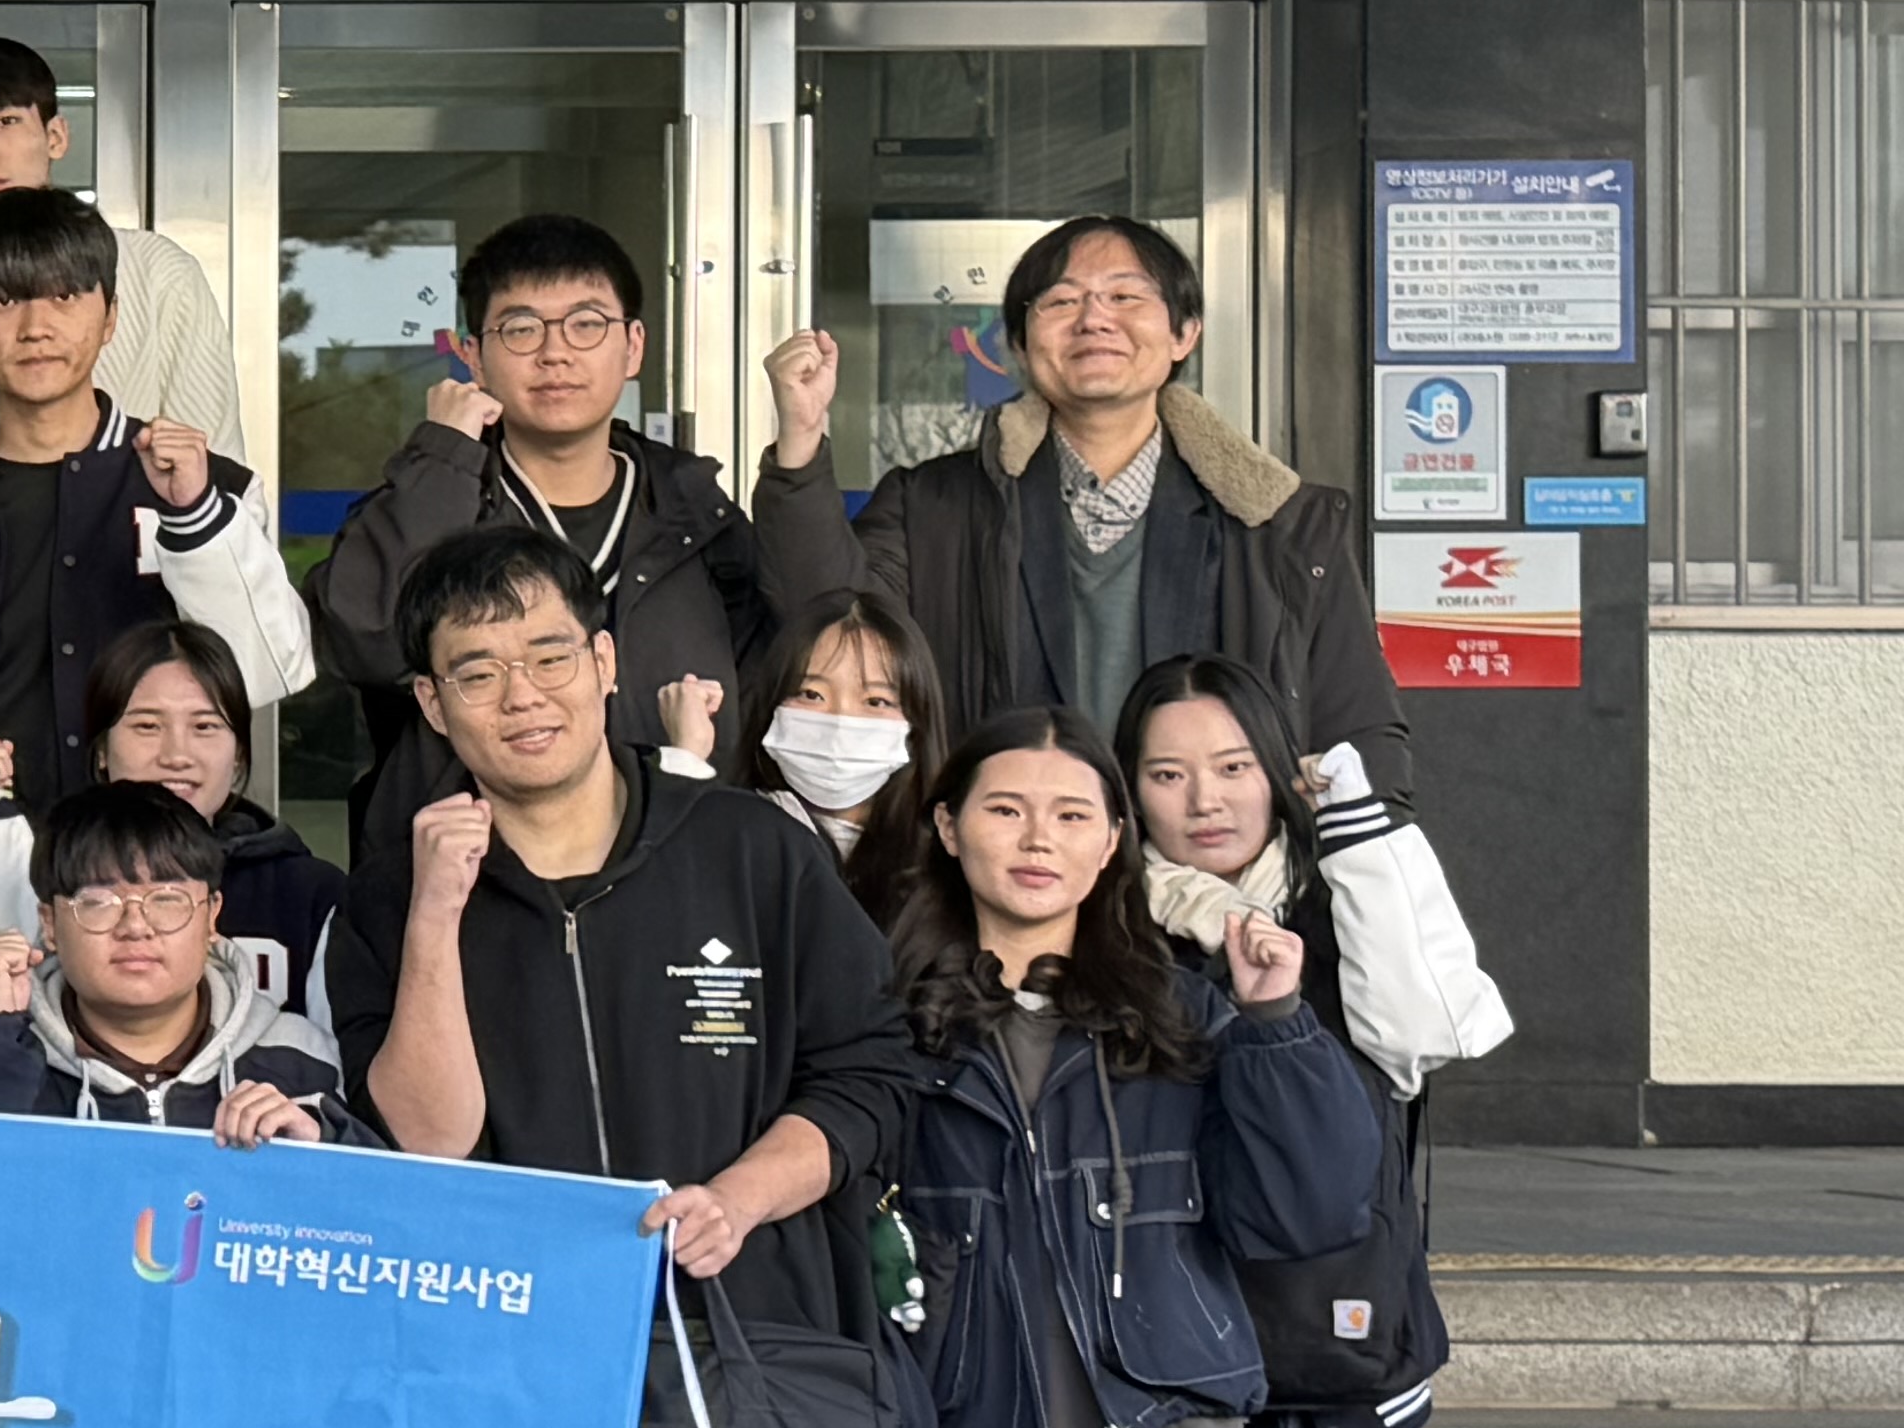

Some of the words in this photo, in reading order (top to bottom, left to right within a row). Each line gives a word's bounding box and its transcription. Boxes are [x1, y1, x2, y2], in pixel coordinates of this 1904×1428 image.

[1436, 595, 1480, 607] KOREA
[1483, 595, 1517, 607] POST
[1444, 653, 1512, 676] 우체국
[214, 1241, 534, 1315] 대학혁신지원사업
